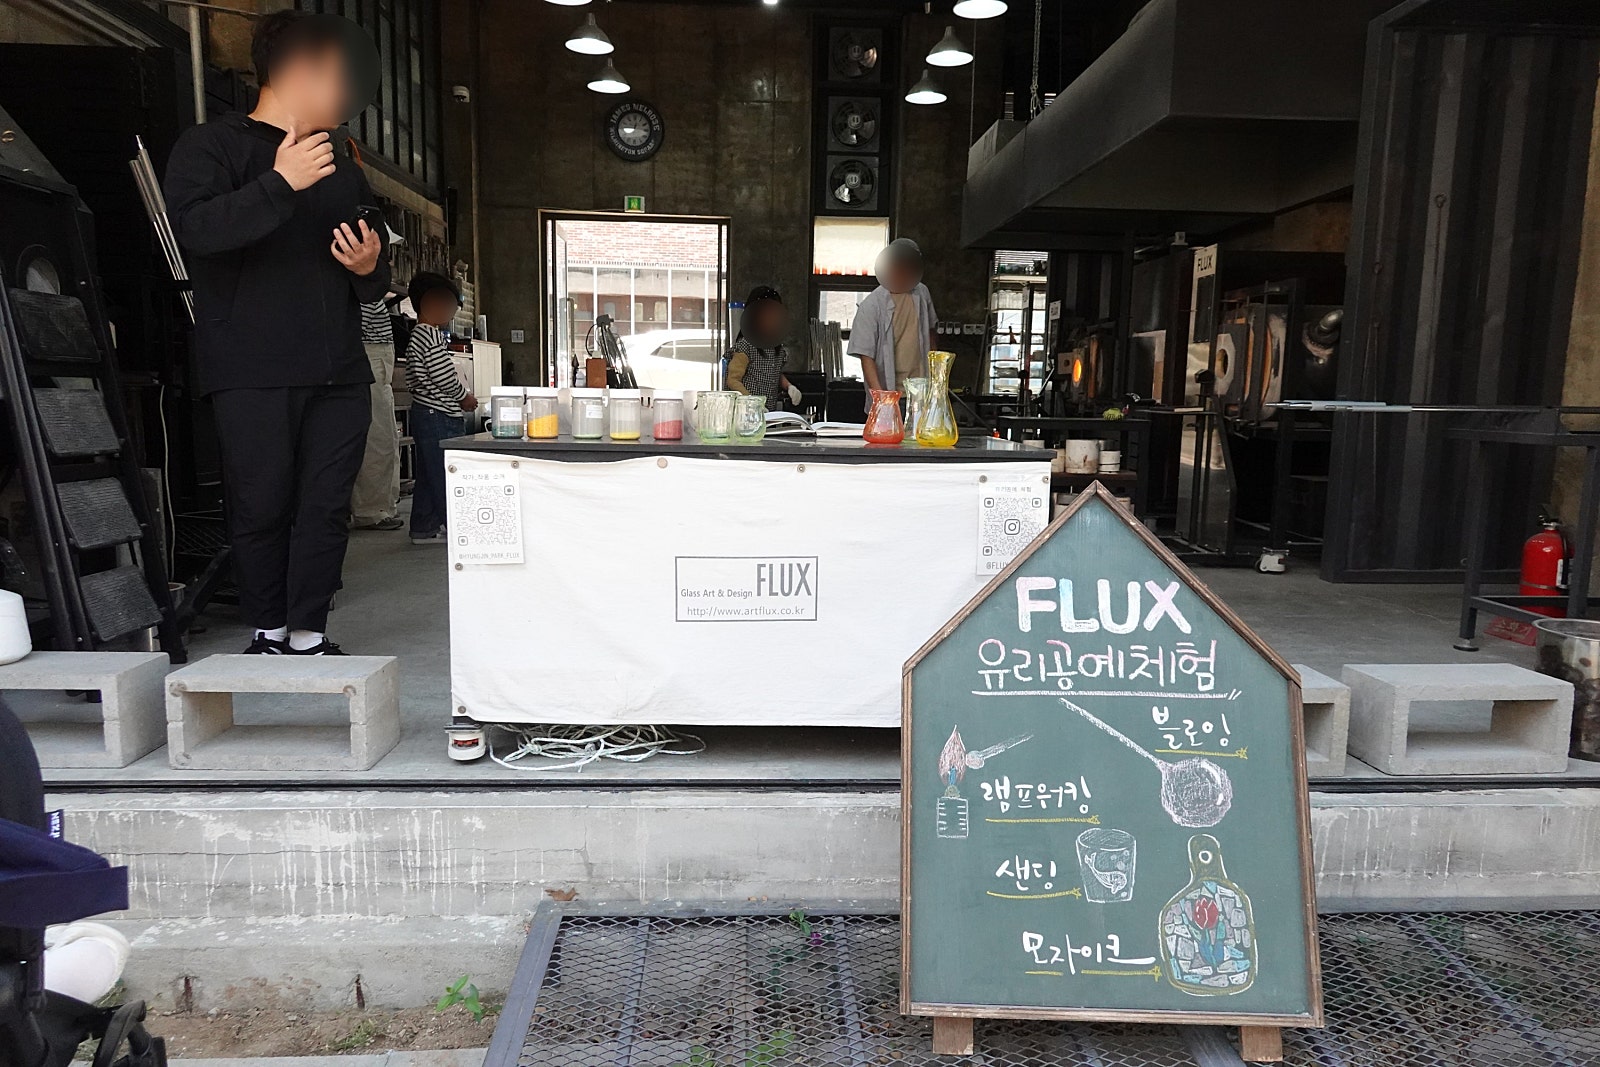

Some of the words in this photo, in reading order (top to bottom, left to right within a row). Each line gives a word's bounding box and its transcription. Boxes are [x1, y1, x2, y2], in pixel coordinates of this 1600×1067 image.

[632, 103, 660, 131] MELROSE
[1197, 255, 1213, 272] FLUX
[680, 588, 701, 598] Glass
[703, 588, 715, 598] Art
[717, 588, 725, 598] &
[727, 588, 753, 600] Design
[756, 562, 812, 597] FLUX
[687, 606, 805, 618] http://www.artflux.co.kr
[1015, 576, 1192, 633] FLUX
[977, 638, 1218, 692] 유리공예체험
[1151, 706, 1232, 750] 블로잉
[980, 775, 1092, 814] 램프워킹
[994, 854, 1057, 891] 샌딩
[1022, 931, 1156, 975] 모자이크
